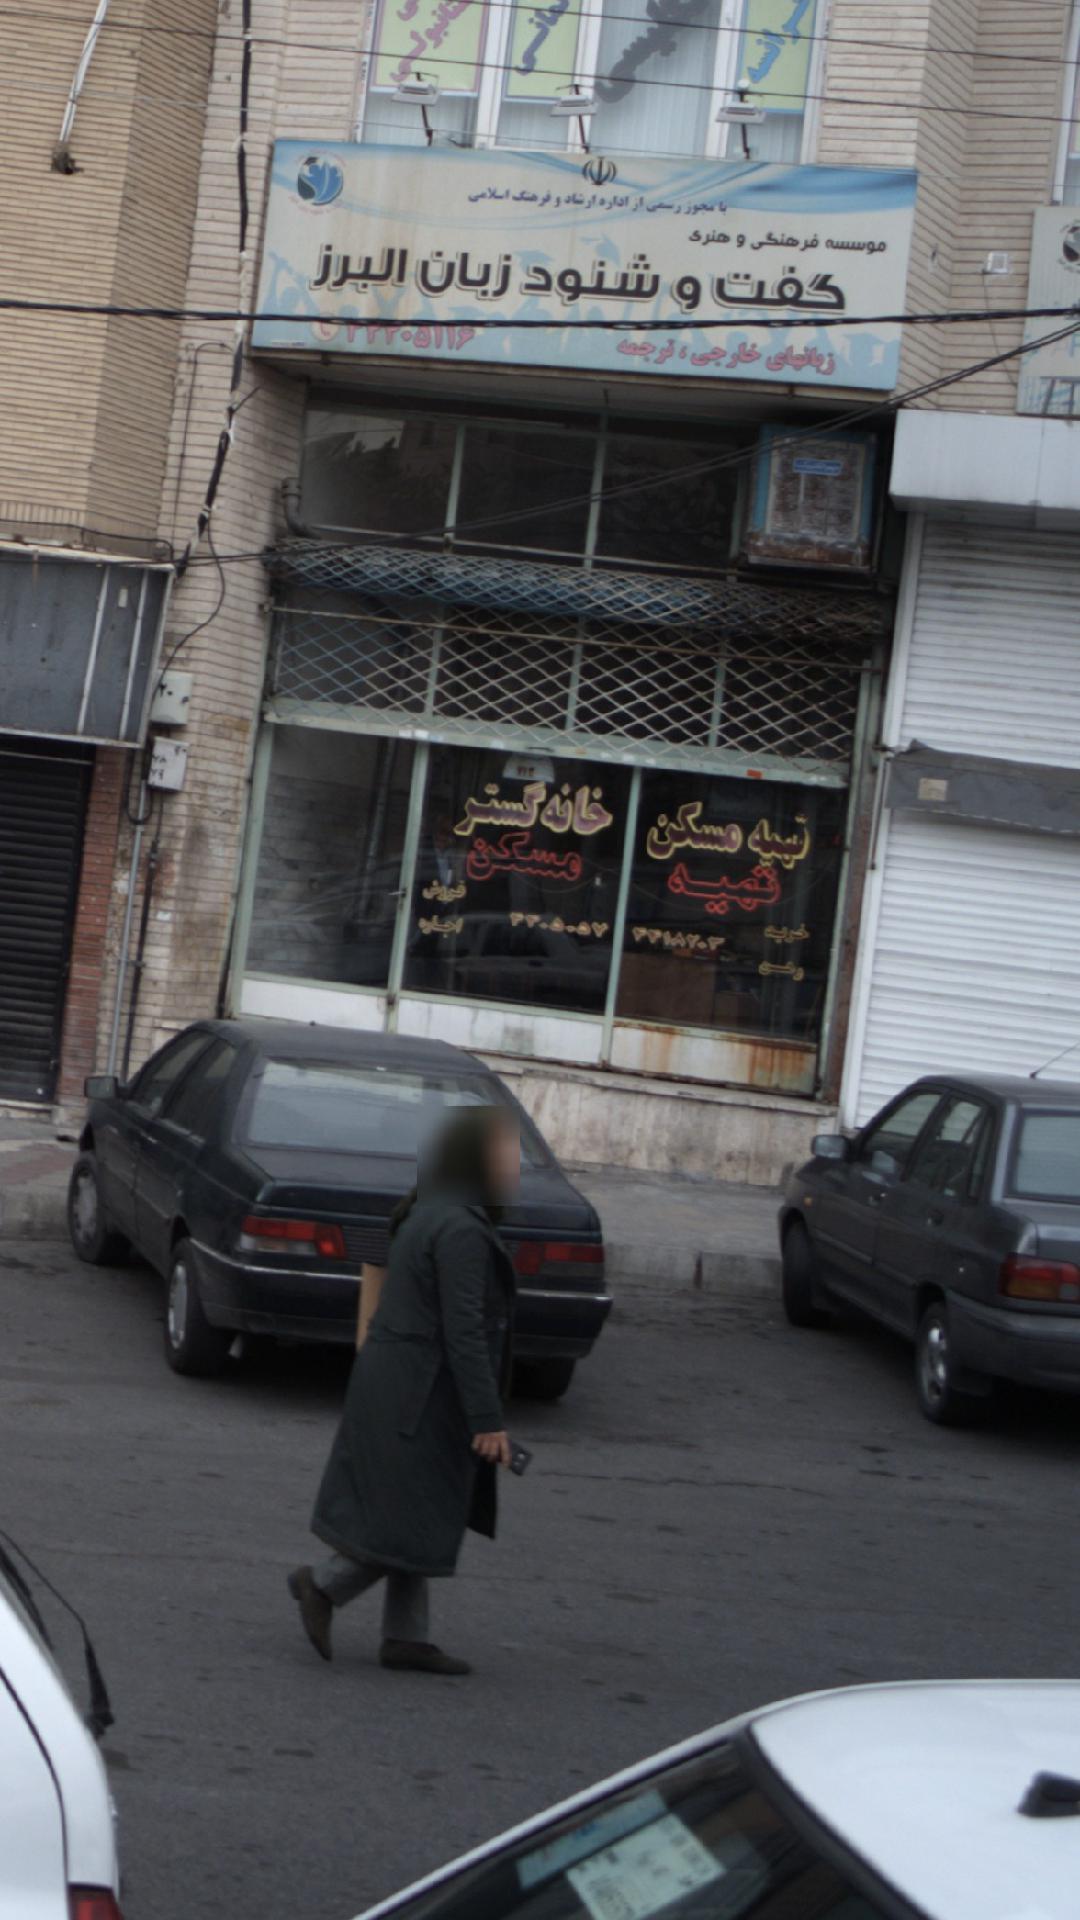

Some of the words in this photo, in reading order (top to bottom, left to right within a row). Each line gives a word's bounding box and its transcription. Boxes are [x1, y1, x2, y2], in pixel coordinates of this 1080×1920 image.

[468, 186, 510, 202] اسلامی
[511, 189, 552, 207] فرهنگ
[554, 196, 561, 208] و
[564, 193, 597, 209] ارشاد
[600, 194, 629, 210] اداره
[632, 196, 645, 212] از
[646, 202, 681, 214] رسمی
[684, 202, 715, 215] مجوز
[688, 229, 731, 246] هنری
[736, 234, 746, 248] و
[751, 233, 819, 251] فرهنگی
[825, 239, 887, 255] موسسه
[311, 243, 409, 291] البرز
[418, 250, 512, 298] زبان
[522, 253, 661, 303] شنود
[675, 274, 703, 312] و
[714, 266, 847, 312] گفت
[616, 338, 676, 364] ترجمه
[691, 342, 762, 368] خارجی
[766, 344, 835, 375] زبانهای
[453, 781, 547, 836] گستر
[540, 783, 614, 835] خانه
[646, 801, 743, 860] مسکن
[748, 814, 811, 869] تهیه
[466, 831, 583, 881] مسکن
